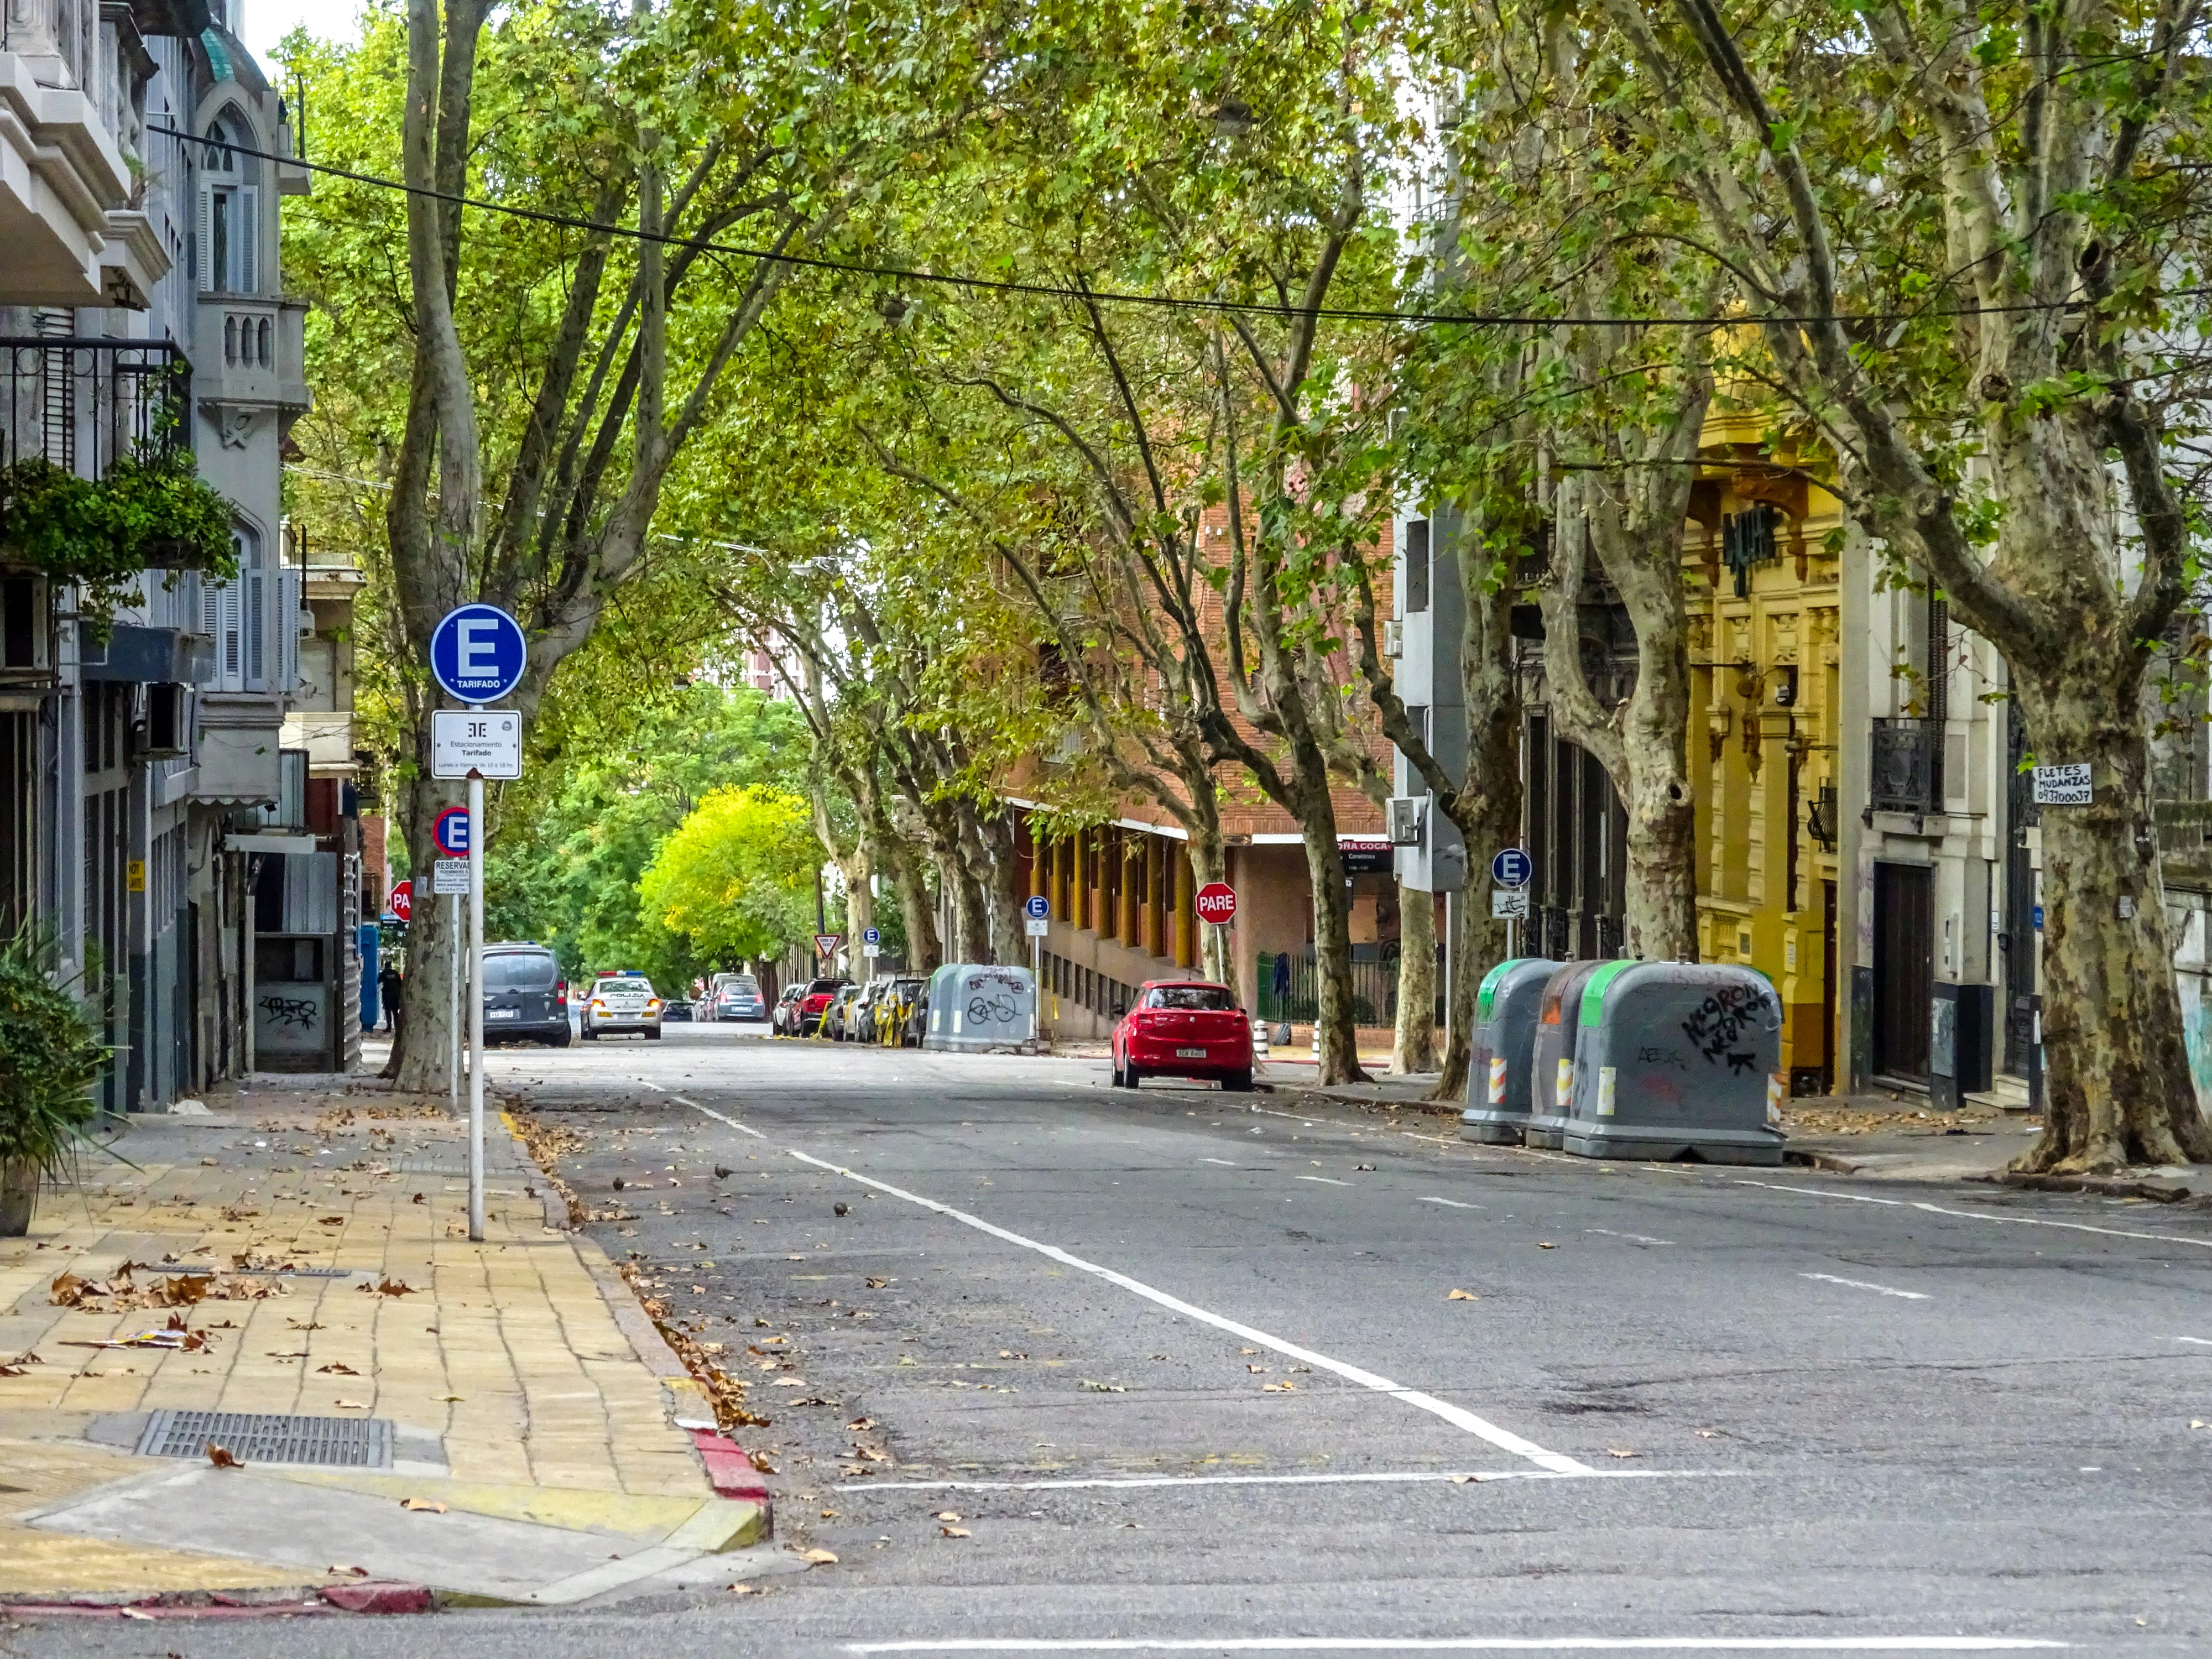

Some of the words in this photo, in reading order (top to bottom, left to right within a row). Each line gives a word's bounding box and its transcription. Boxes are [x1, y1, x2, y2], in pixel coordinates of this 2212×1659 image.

[457, 619, 499, 677] E
[457, 680, 500, 688] TARIFADO
[2038, 765, 2081, 778] FLETES
[2039, 775, 2091, 788] MUDANZAS
[448, 817, 468, 848] E
[1503, 854, 1521, 878] E
[1032, 899, 1042, 912] E
[1199, 894, 1234, 911] PARE
[867, 930, 875, 940] E
